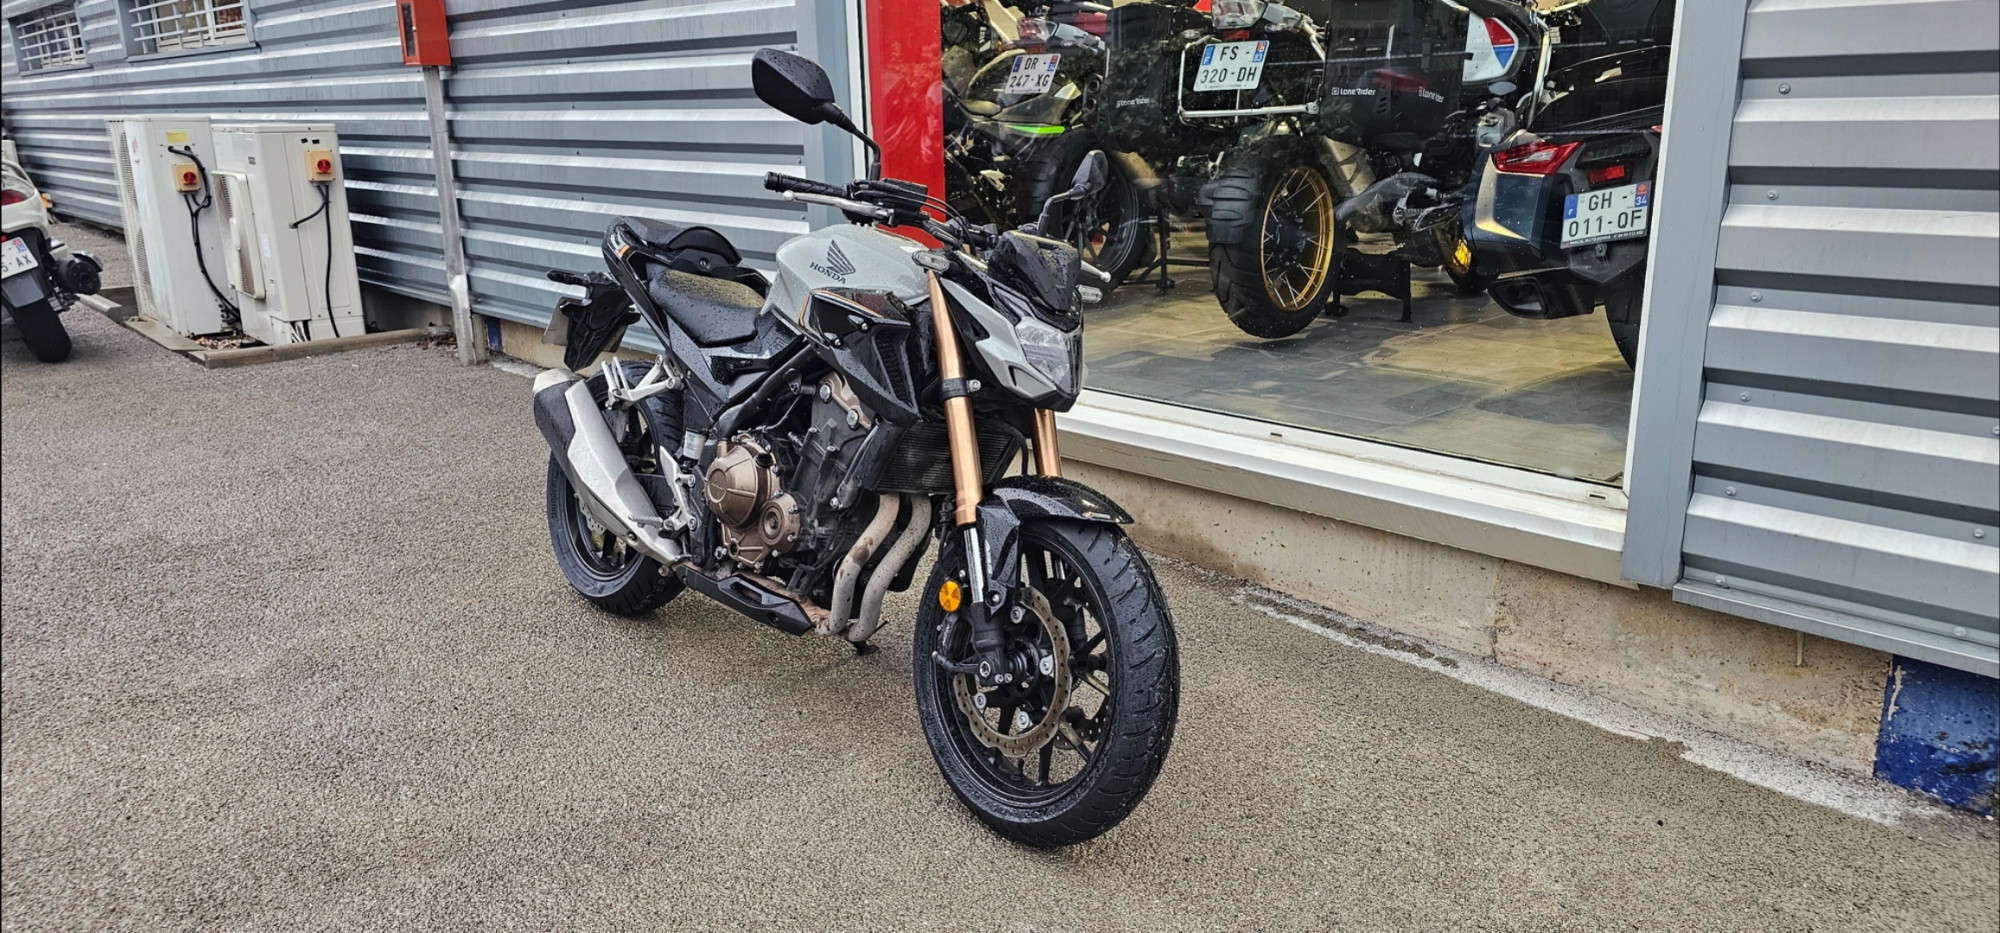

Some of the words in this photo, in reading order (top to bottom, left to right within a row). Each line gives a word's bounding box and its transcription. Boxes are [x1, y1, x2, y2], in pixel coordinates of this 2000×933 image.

[1588, 191, 1613, 211] GH
[1635, 196, 1647, 206] 34
[809, 261, 846, 284] HONDA
